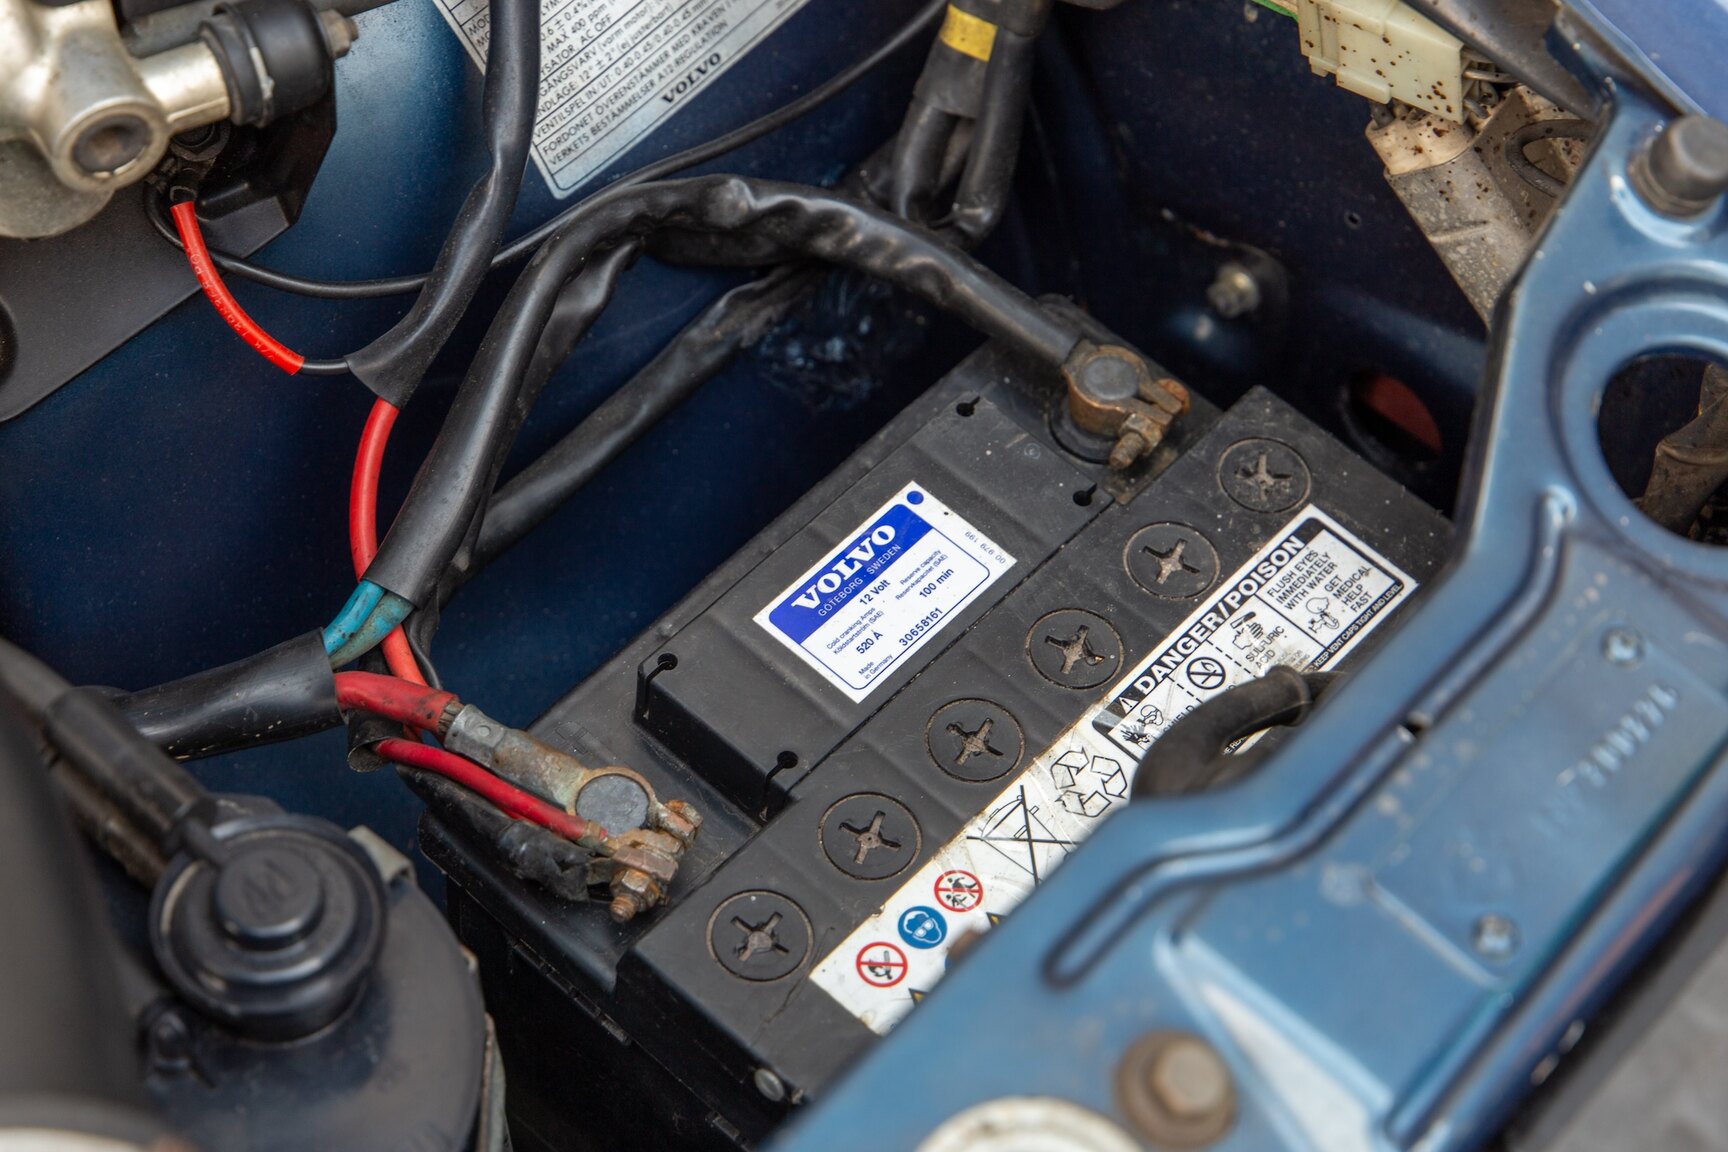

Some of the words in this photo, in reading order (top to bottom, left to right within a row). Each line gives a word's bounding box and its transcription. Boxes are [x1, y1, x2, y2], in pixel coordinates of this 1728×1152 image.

[546, 33, 568, 53] MAX
[571, 17, 585, 33] 400
[580, 28, 593, 44] AC
[593, 13, 610, 32] OFF
[542, 112, 593, 154] FORDONET
[671, 33, 690, 52] MED
[661, 52, 720, 103] VOLVO
[532, 97, 585, 137] VENTILSPEL
[549, 132, 589, 165] VERKETS
[589, 79, 655, 136] BESTÄMMELSER
[792, 525, 894, 608] VOLVO
[899, 567, 920, 585] Reserve
[919, 549, 941, 567] capacity
[932, 554, 948, 567] (SAE)
[1266, 570, 1296, 597] FLUSH
[1294, 549, 1318, 572] EYES
[1276, 552, 1330, 603] IMMEDIATELY
[817, 577, 863, 616] GÖTEBORG
[866, 544, 900, 574] SWEDEN
[859, 593, 873, 604] 12
[869, 579, 890, 594] Volt
[919, 582, 936, 597] 100
[935, 568, 954, 584] min
[1284, 588, 1309, 609] WITH
[1306, 561, 1337, 589] WATER
[1323, 574, 1342, 592] GET
[1332, 566, 1370, 599] MEDICAL
[1341, 583, 1363, 605] HELP
[868, 610, 884, 624] (SAE)
[1133, 537, 1306, 693] DANGER/POISON
[1349, 591, 1372, 612] FAST
[826, 637, 840, 649] Cold
[839, 619, 862, 639] cranking
[859, 607, 875, 620] Amps
[898, 607, 942, 646] 30658161
[1245, 625, 1284, 662] SULFURIC
[1313, 651, 1328, 667] KEEP
[1327, 637, 1343, 653] VENT
[1341, 623, 1358, 640] CAPS
[1355, 608, 1373, 625] TIGHT
[1371, 598, 1385, 611] AND
[855, 637, 874, 654] 520
[1254, 648, 1275, 669] ACID
[857, 661, 874, 675] Made
[869, 654, 893, 674] Germany
